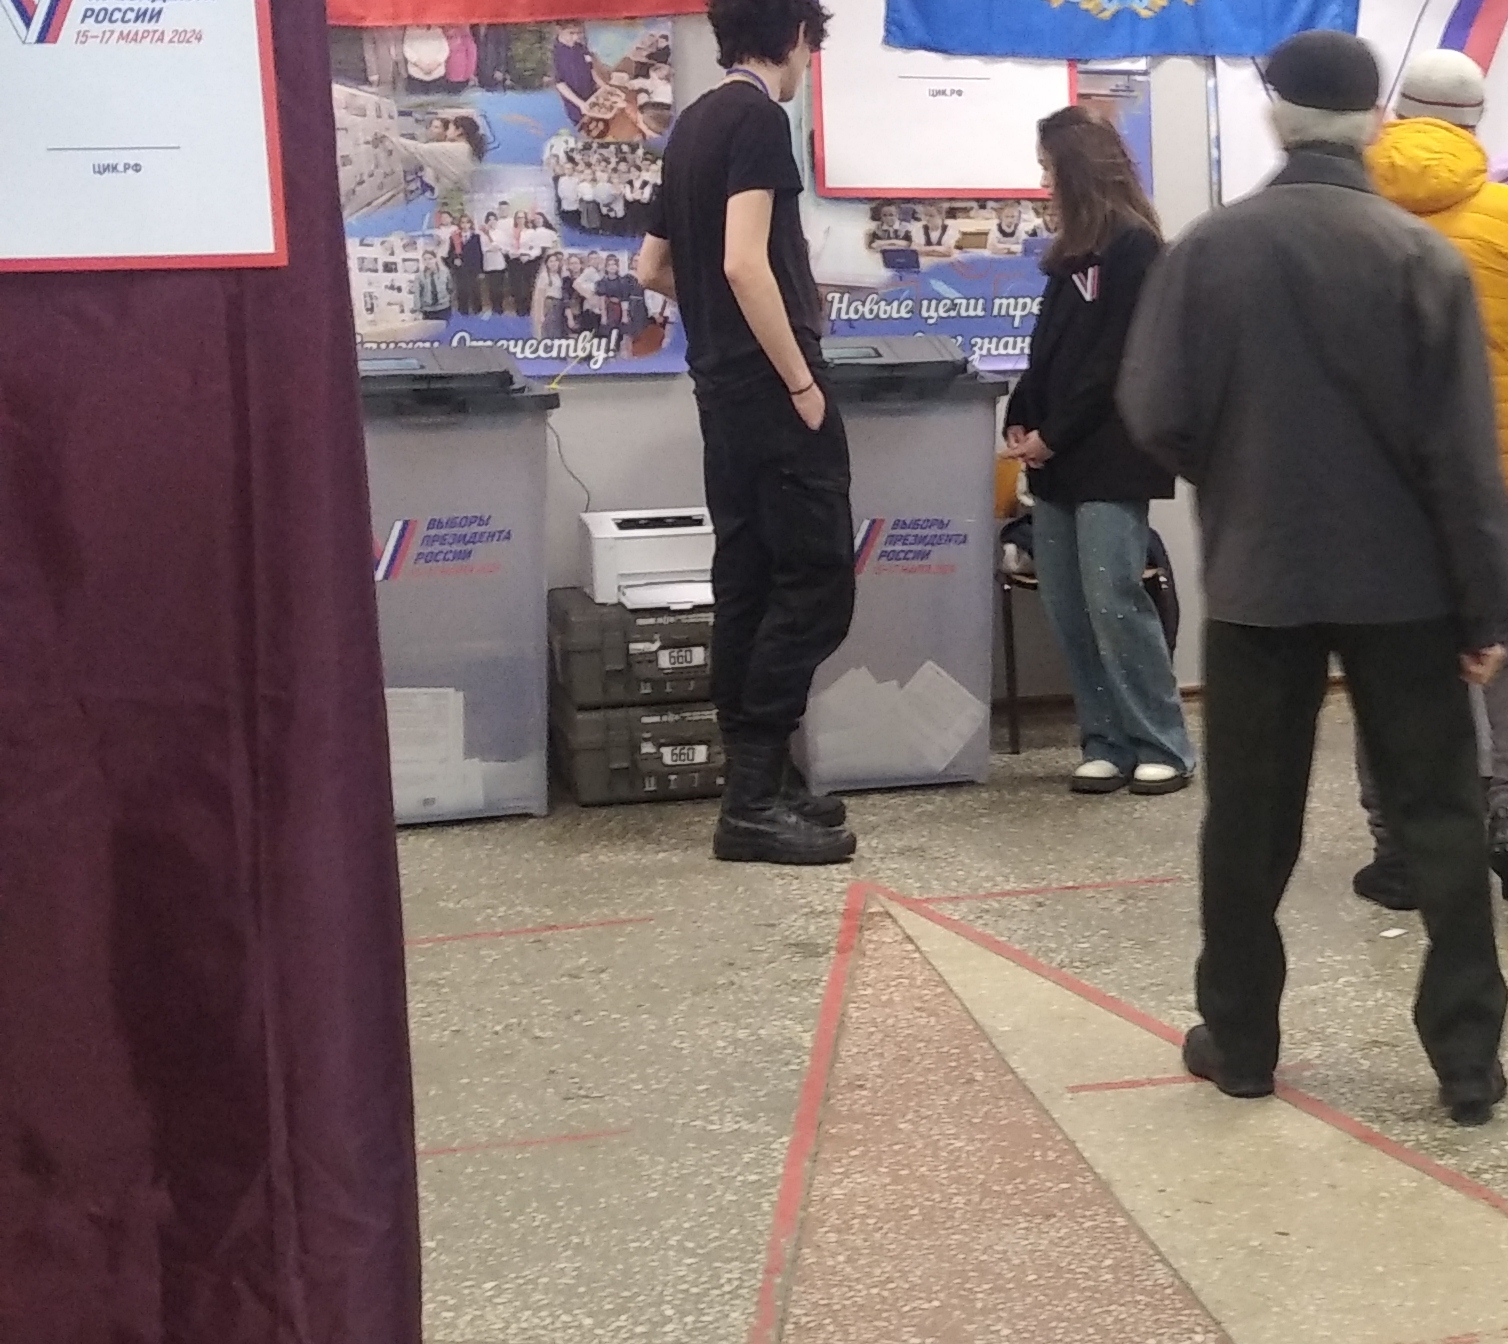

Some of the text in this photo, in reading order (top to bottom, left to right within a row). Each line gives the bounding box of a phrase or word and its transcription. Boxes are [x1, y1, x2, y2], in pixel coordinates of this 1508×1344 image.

[80, 7, 164, 24] РОССИИ
[116, 29, 165, 45] МАРТА
[167, 29, 204, 44] 2024
[92, 162, 142, 176] ЦИК.РФ
[826, 292, 913, 321] Новые
[920, 297, 986, 325] цели
[426, 515, 492, 531] ВЫБОРЫ
[890, 518, 952, 531] ВЫБОРЫ
[420, 529, 512, 548] ПРЕЗИДЕНТА
[883, 533, 969, 547] ПРЕЗИДЕНТА
[413, 548, 474, 565] РОССИИ
[877, 549, 933, 562] РОССИИ
